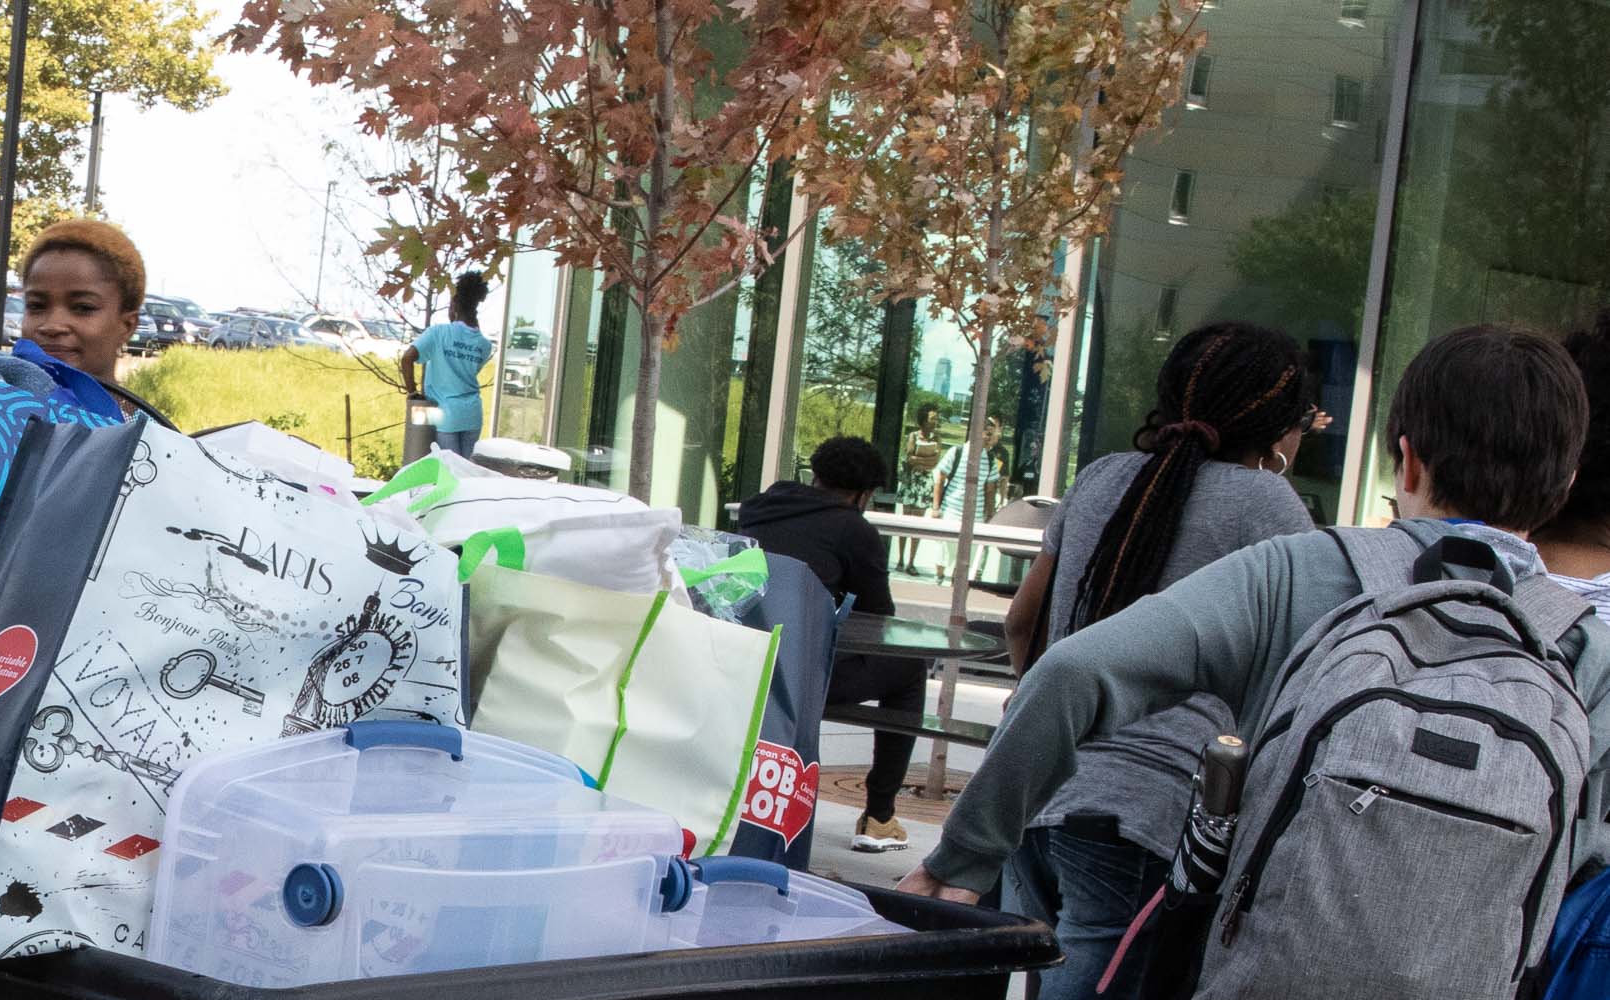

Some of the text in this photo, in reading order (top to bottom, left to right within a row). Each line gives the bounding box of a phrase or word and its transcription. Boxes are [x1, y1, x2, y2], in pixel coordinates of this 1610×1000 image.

[238, 527, 334, 596] PARIS
[134, 602, 200, 637] Bonjour
[342, 672, 360, 688] 08
[756, 748, 798, 767] cean State
